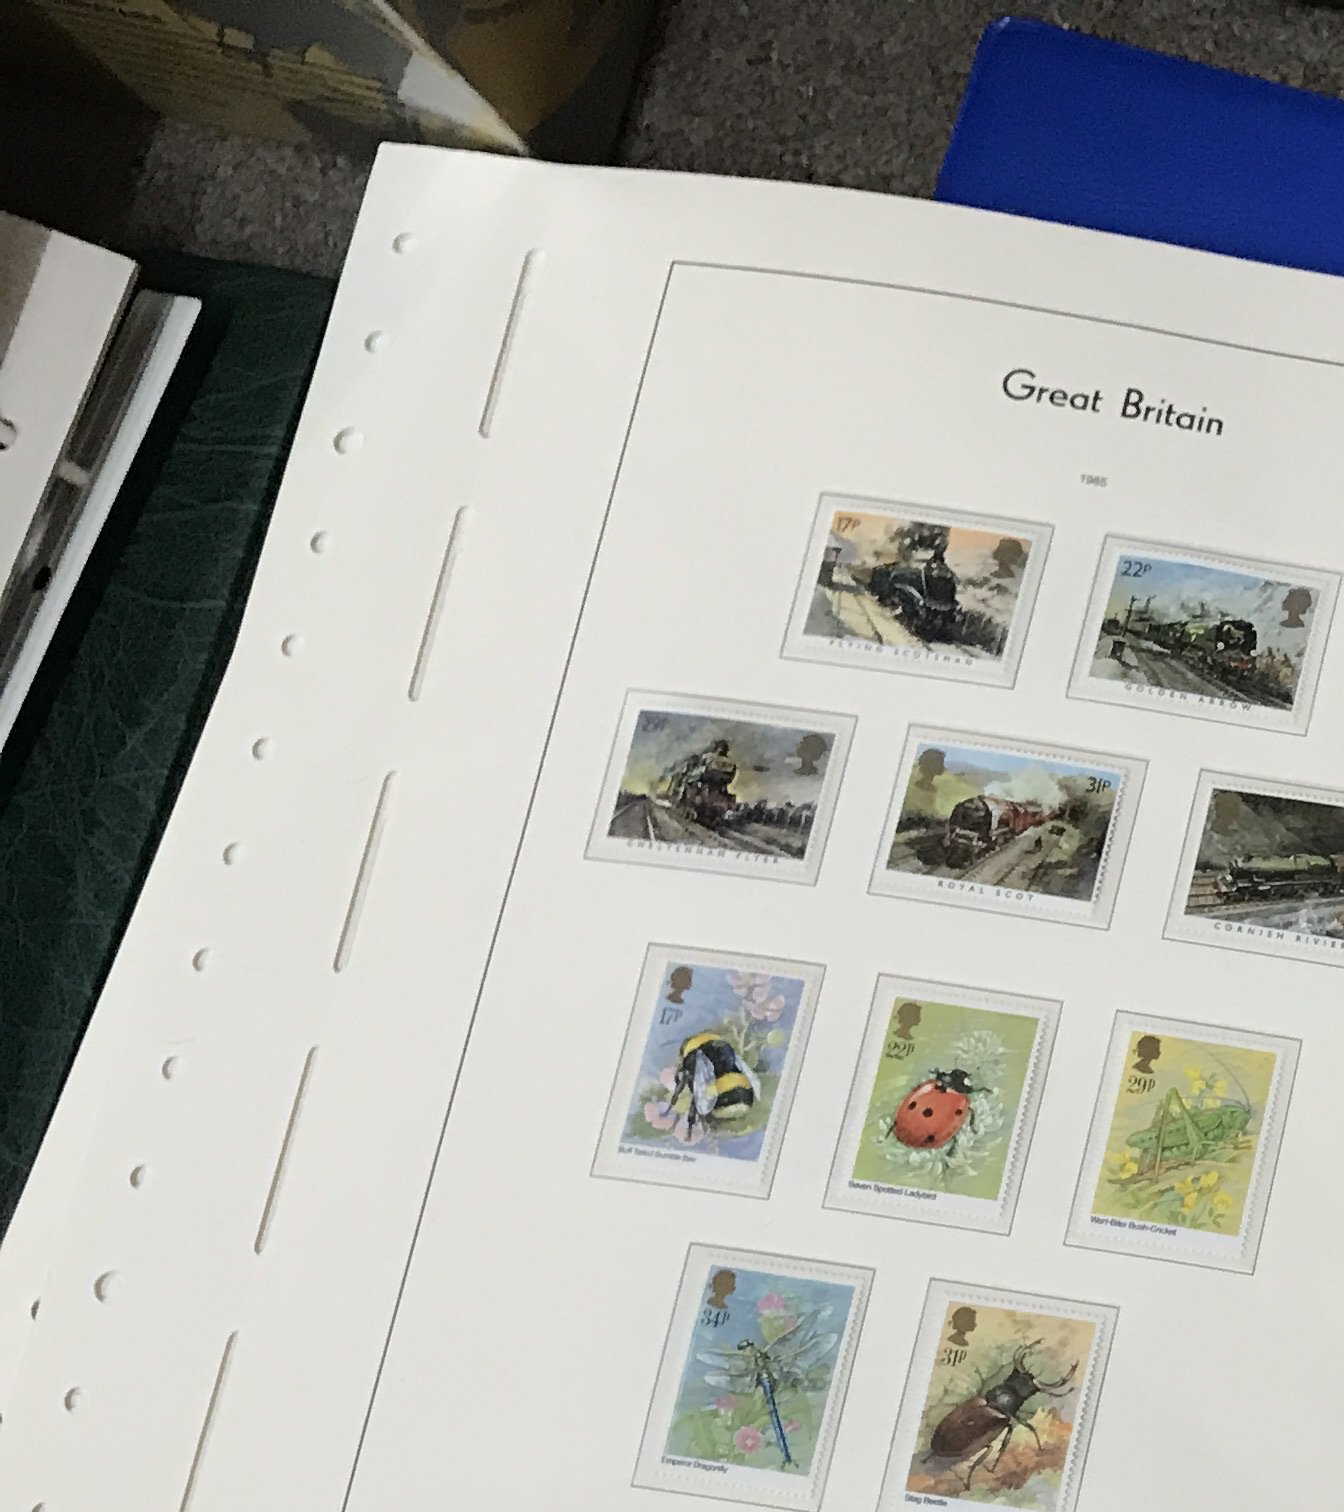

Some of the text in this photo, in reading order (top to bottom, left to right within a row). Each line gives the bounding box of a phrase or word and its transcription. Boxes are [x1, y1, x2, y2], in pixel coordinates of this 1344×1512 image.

[1003, 368, 1223, 435] Great Britain
[938, 880, 1034, 902] ROYAL SCOT
[1214, 922, 1284, 940] CORNISH
